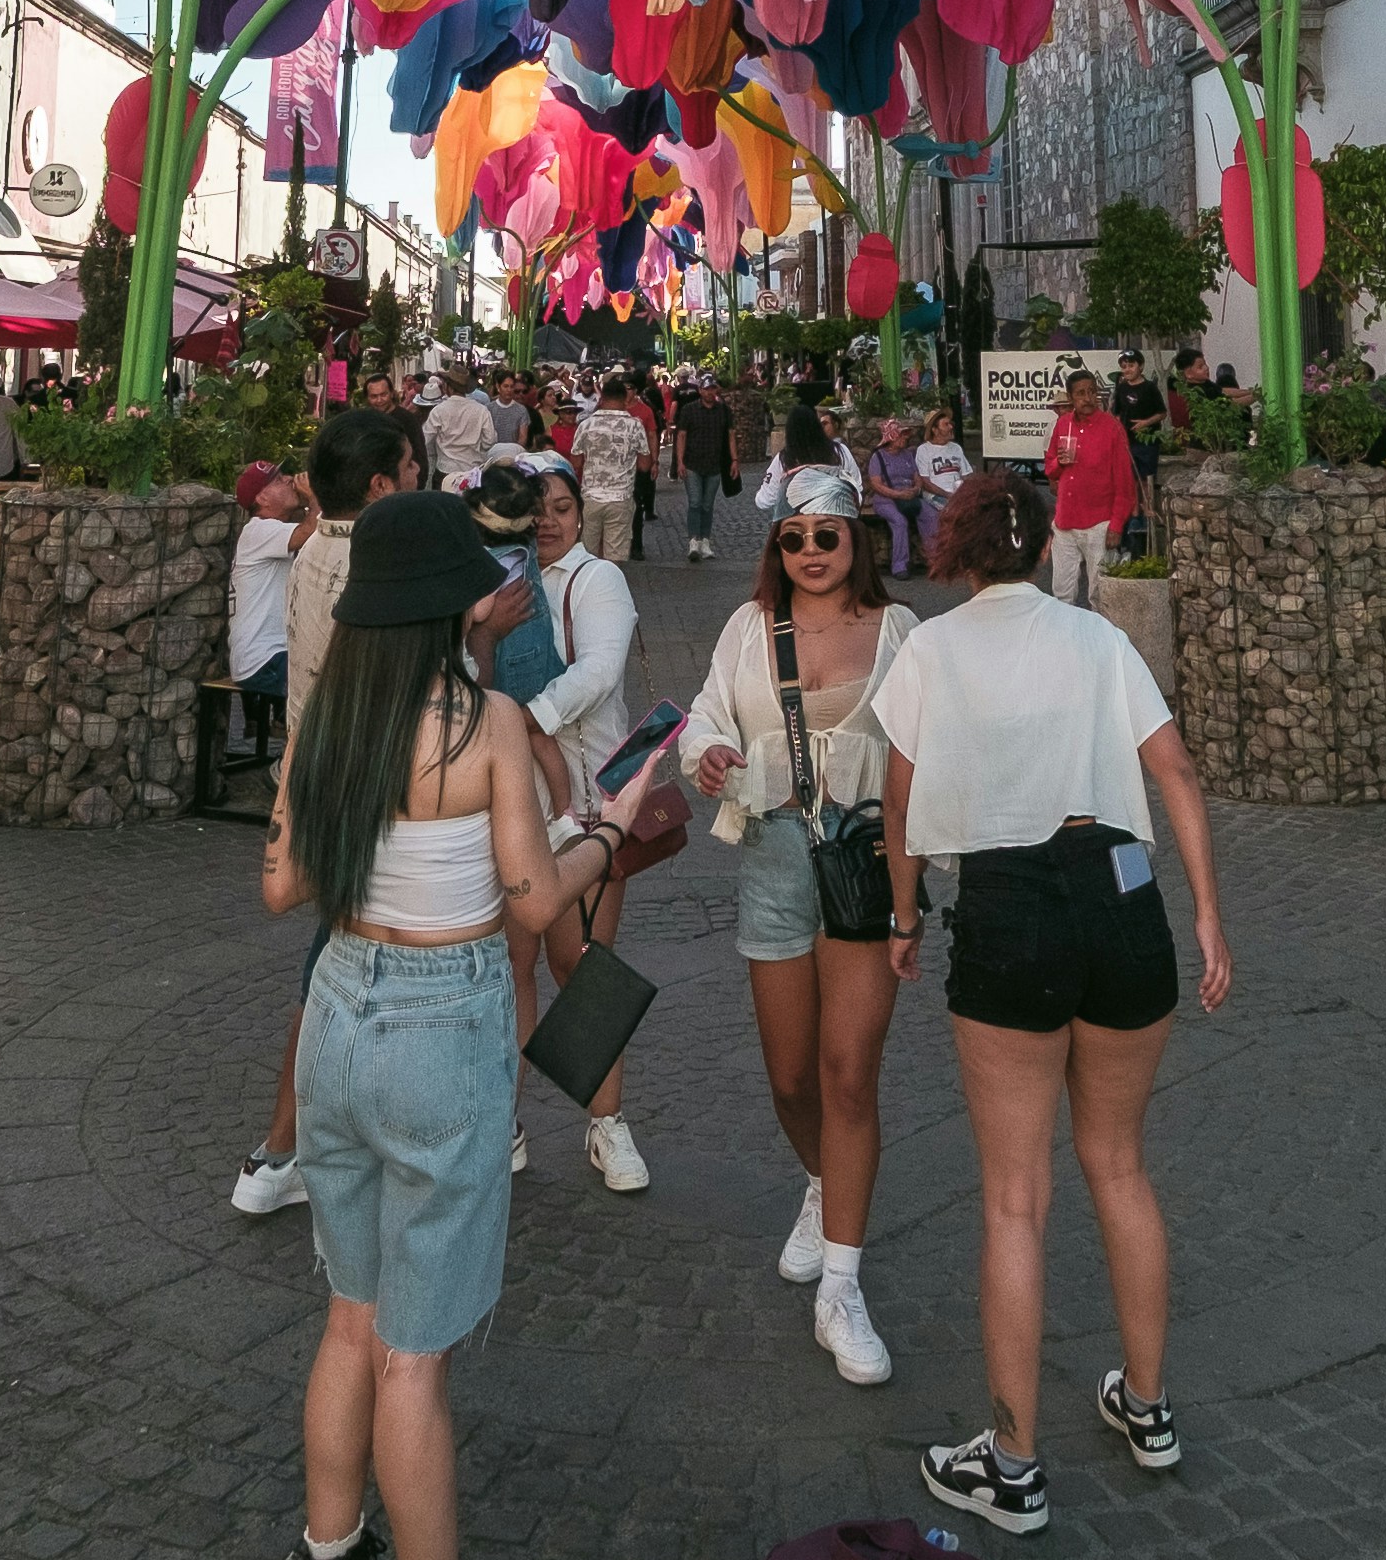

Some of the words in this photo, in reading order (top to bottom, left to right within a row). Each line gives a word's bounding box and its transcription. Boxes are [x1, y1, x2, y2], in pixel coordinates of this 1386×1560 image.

[276, 58, 293, 120] CORREDOR
[988, 367, 1065, 389] POLICÍA
[988, 390, 1060, 402] MUNICIPA
